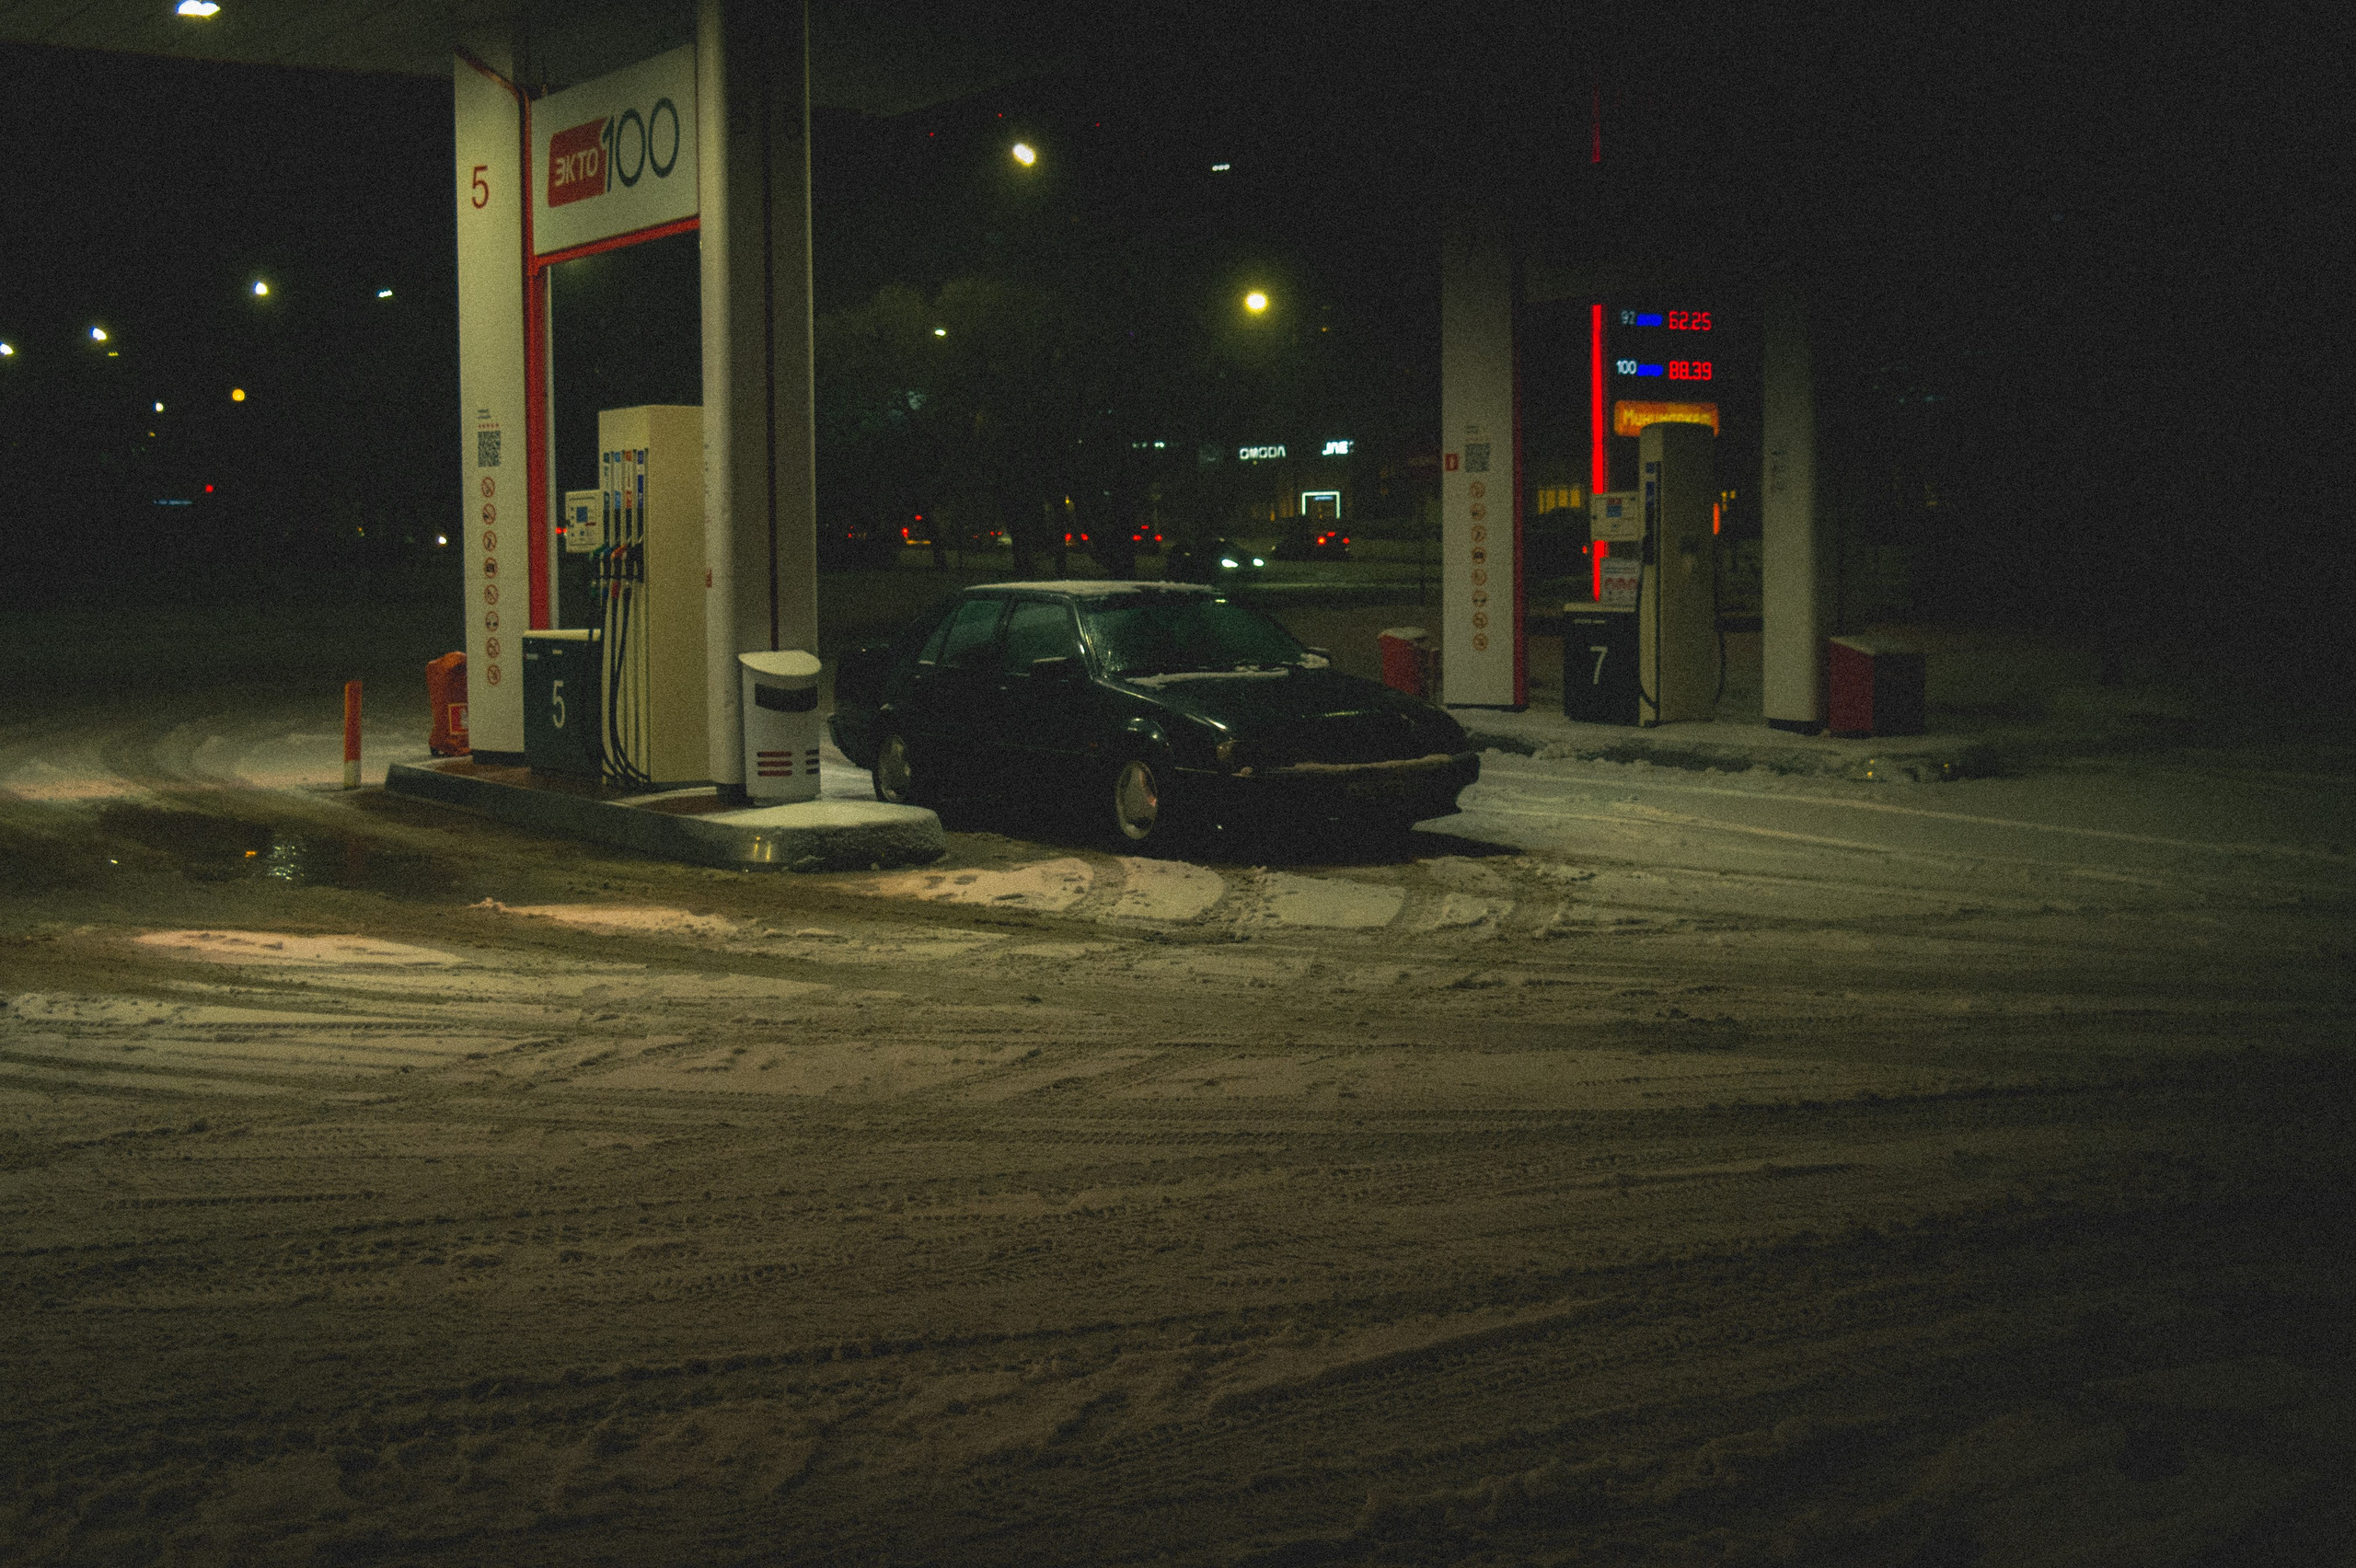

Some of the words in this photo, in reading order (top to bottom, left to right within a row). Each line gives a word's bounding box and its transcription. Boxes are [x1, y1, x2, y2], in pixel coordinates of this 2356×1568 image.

[554, 147, 600, 188] ЭКТО
[601, 97, 681, 193] 100
[471, 165, 490, 209] 5
[1669, 310, 1713, 331] 62.25
[1616, 359, 1637, 375] 100
[1669, 360, 1713, 381] 88.39
[1589, 646, 1608, 685] 7
[552, 679, 566, 730] 5
